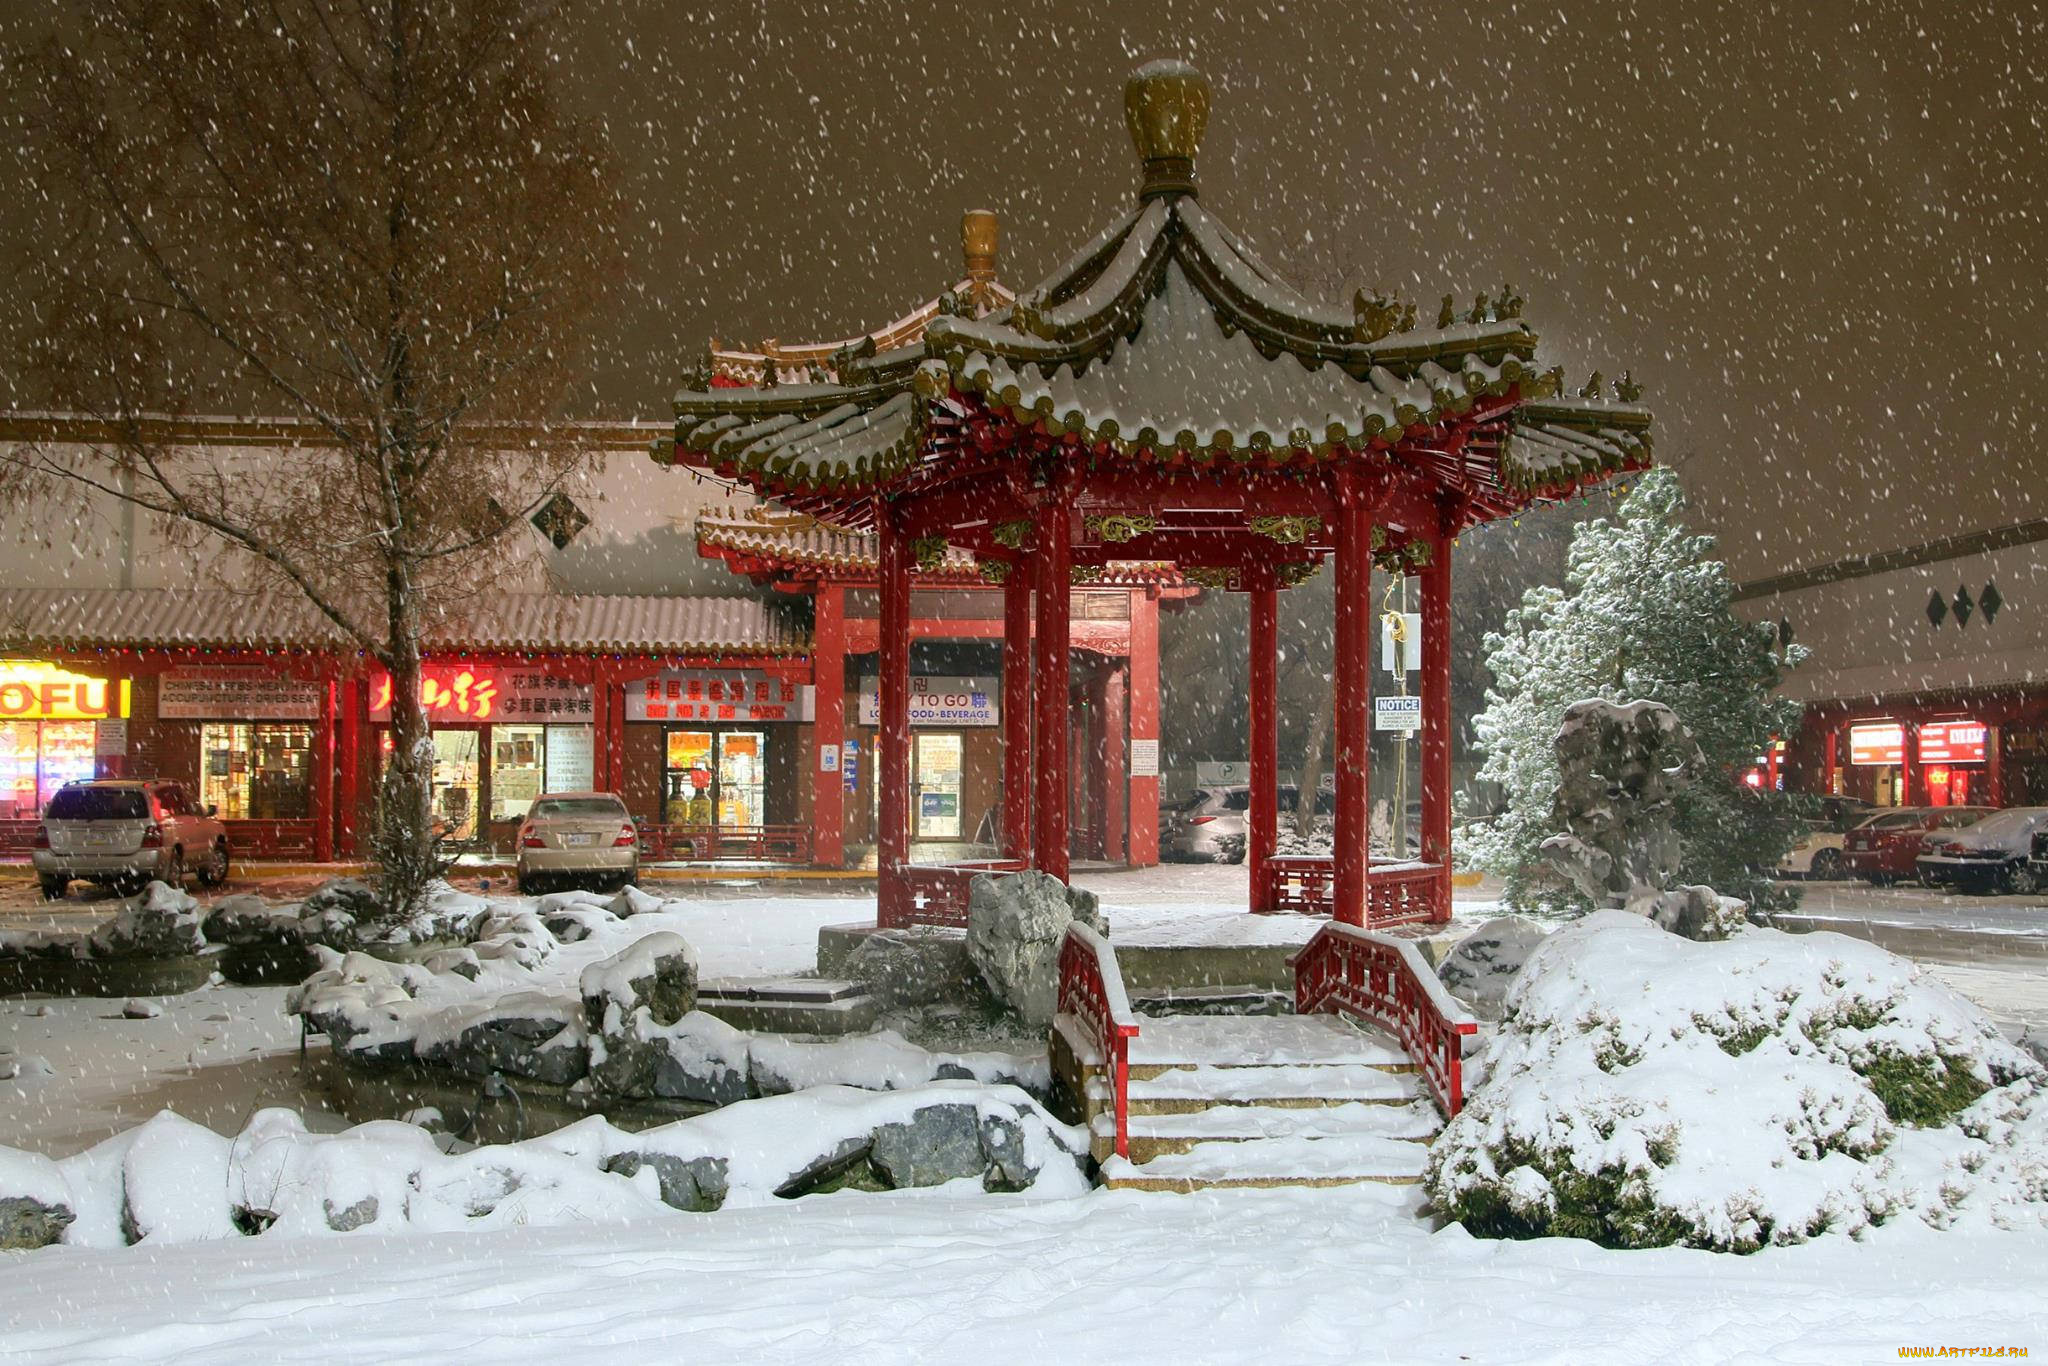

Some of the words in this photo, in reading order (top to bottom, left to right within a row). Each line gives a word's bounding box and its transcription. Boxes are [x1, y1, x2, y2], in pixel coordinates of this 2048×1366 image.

[918, 694, 939, 706] TO
[944, 694, 968, 706] GO
[1380, 700, 1418, 710] NOTICE
[940, 710, 990, 718] BEVERAGE
